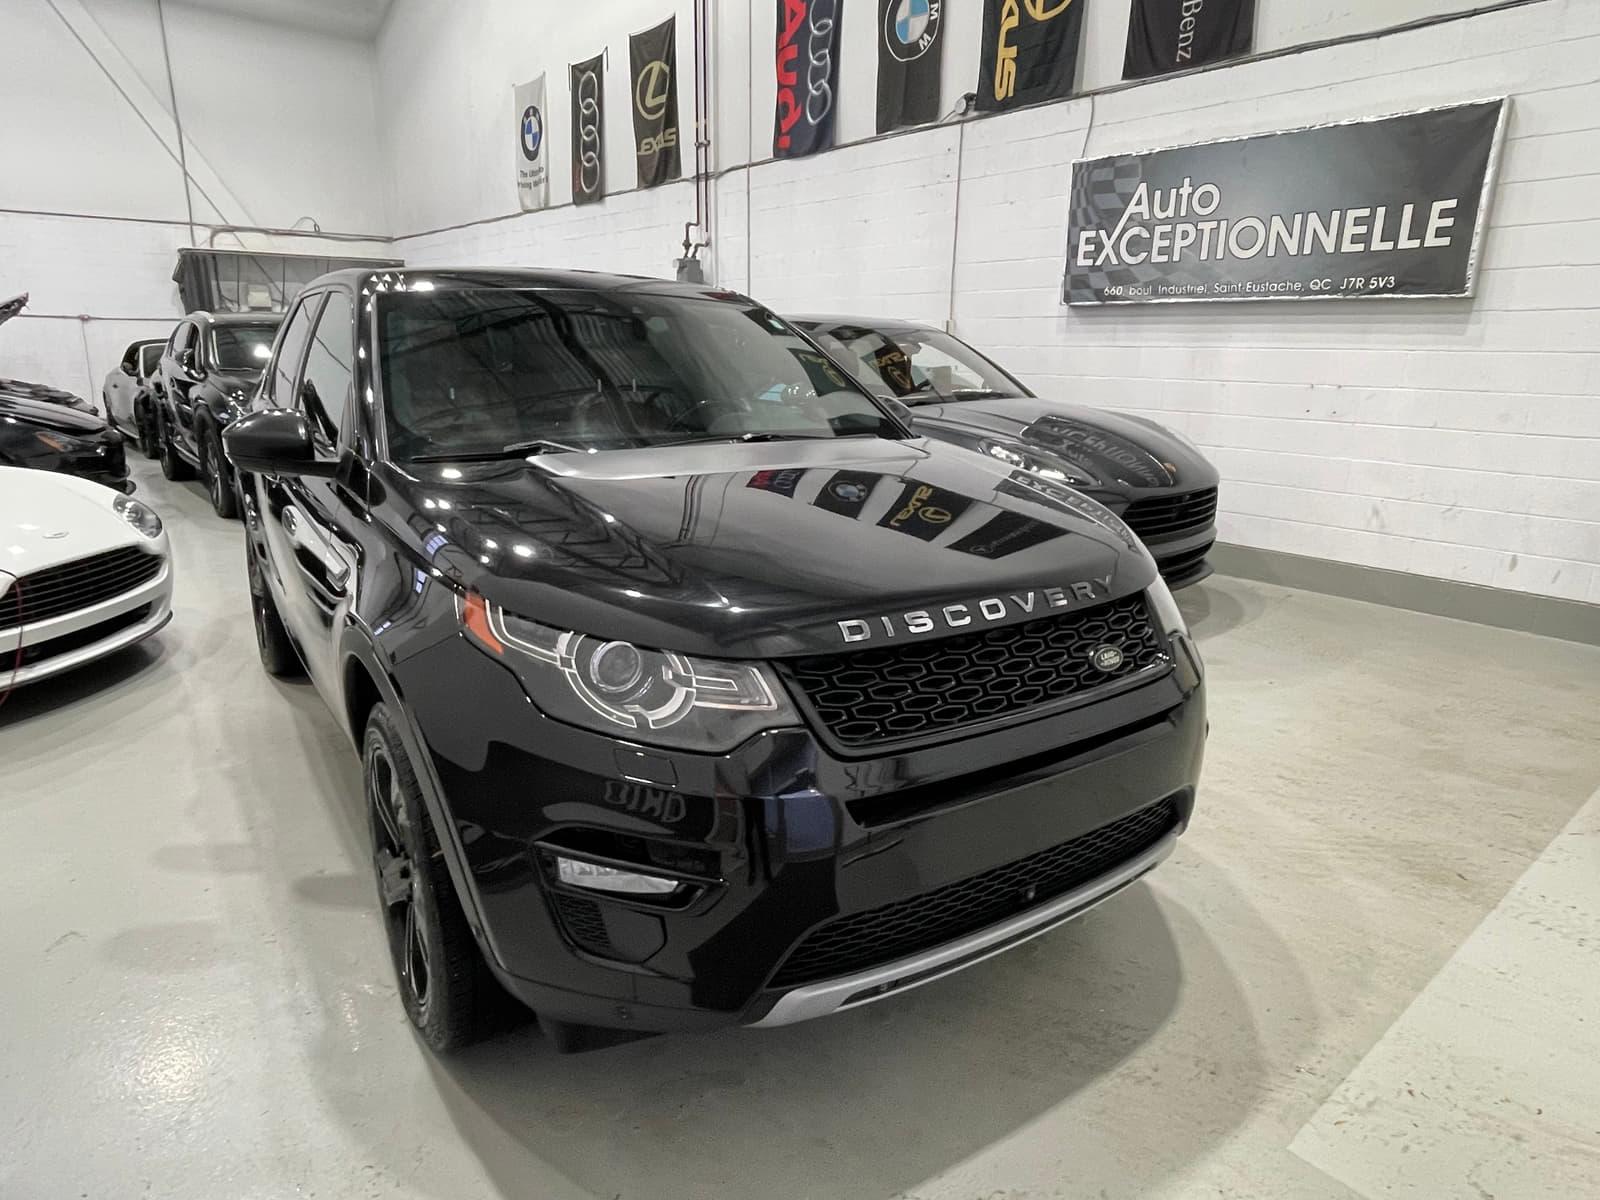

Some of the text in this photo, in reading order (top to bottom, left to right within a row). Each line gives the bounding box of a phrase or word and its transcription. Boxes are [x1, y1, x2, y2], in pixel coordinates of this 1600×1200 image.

[1176, 0, 1203, 62] Benz
[1122, 177, 1221, 220] Auto
[1076, 198, 1459, 267] EXCEPTIONNELLE
[1309, 278, 1332, 291] QC
[1339, 277, 1365, 290] J7R
[1368, 276, 1396, 289] 5V3
[837, 575, 1112, 643] DISCOVERY
